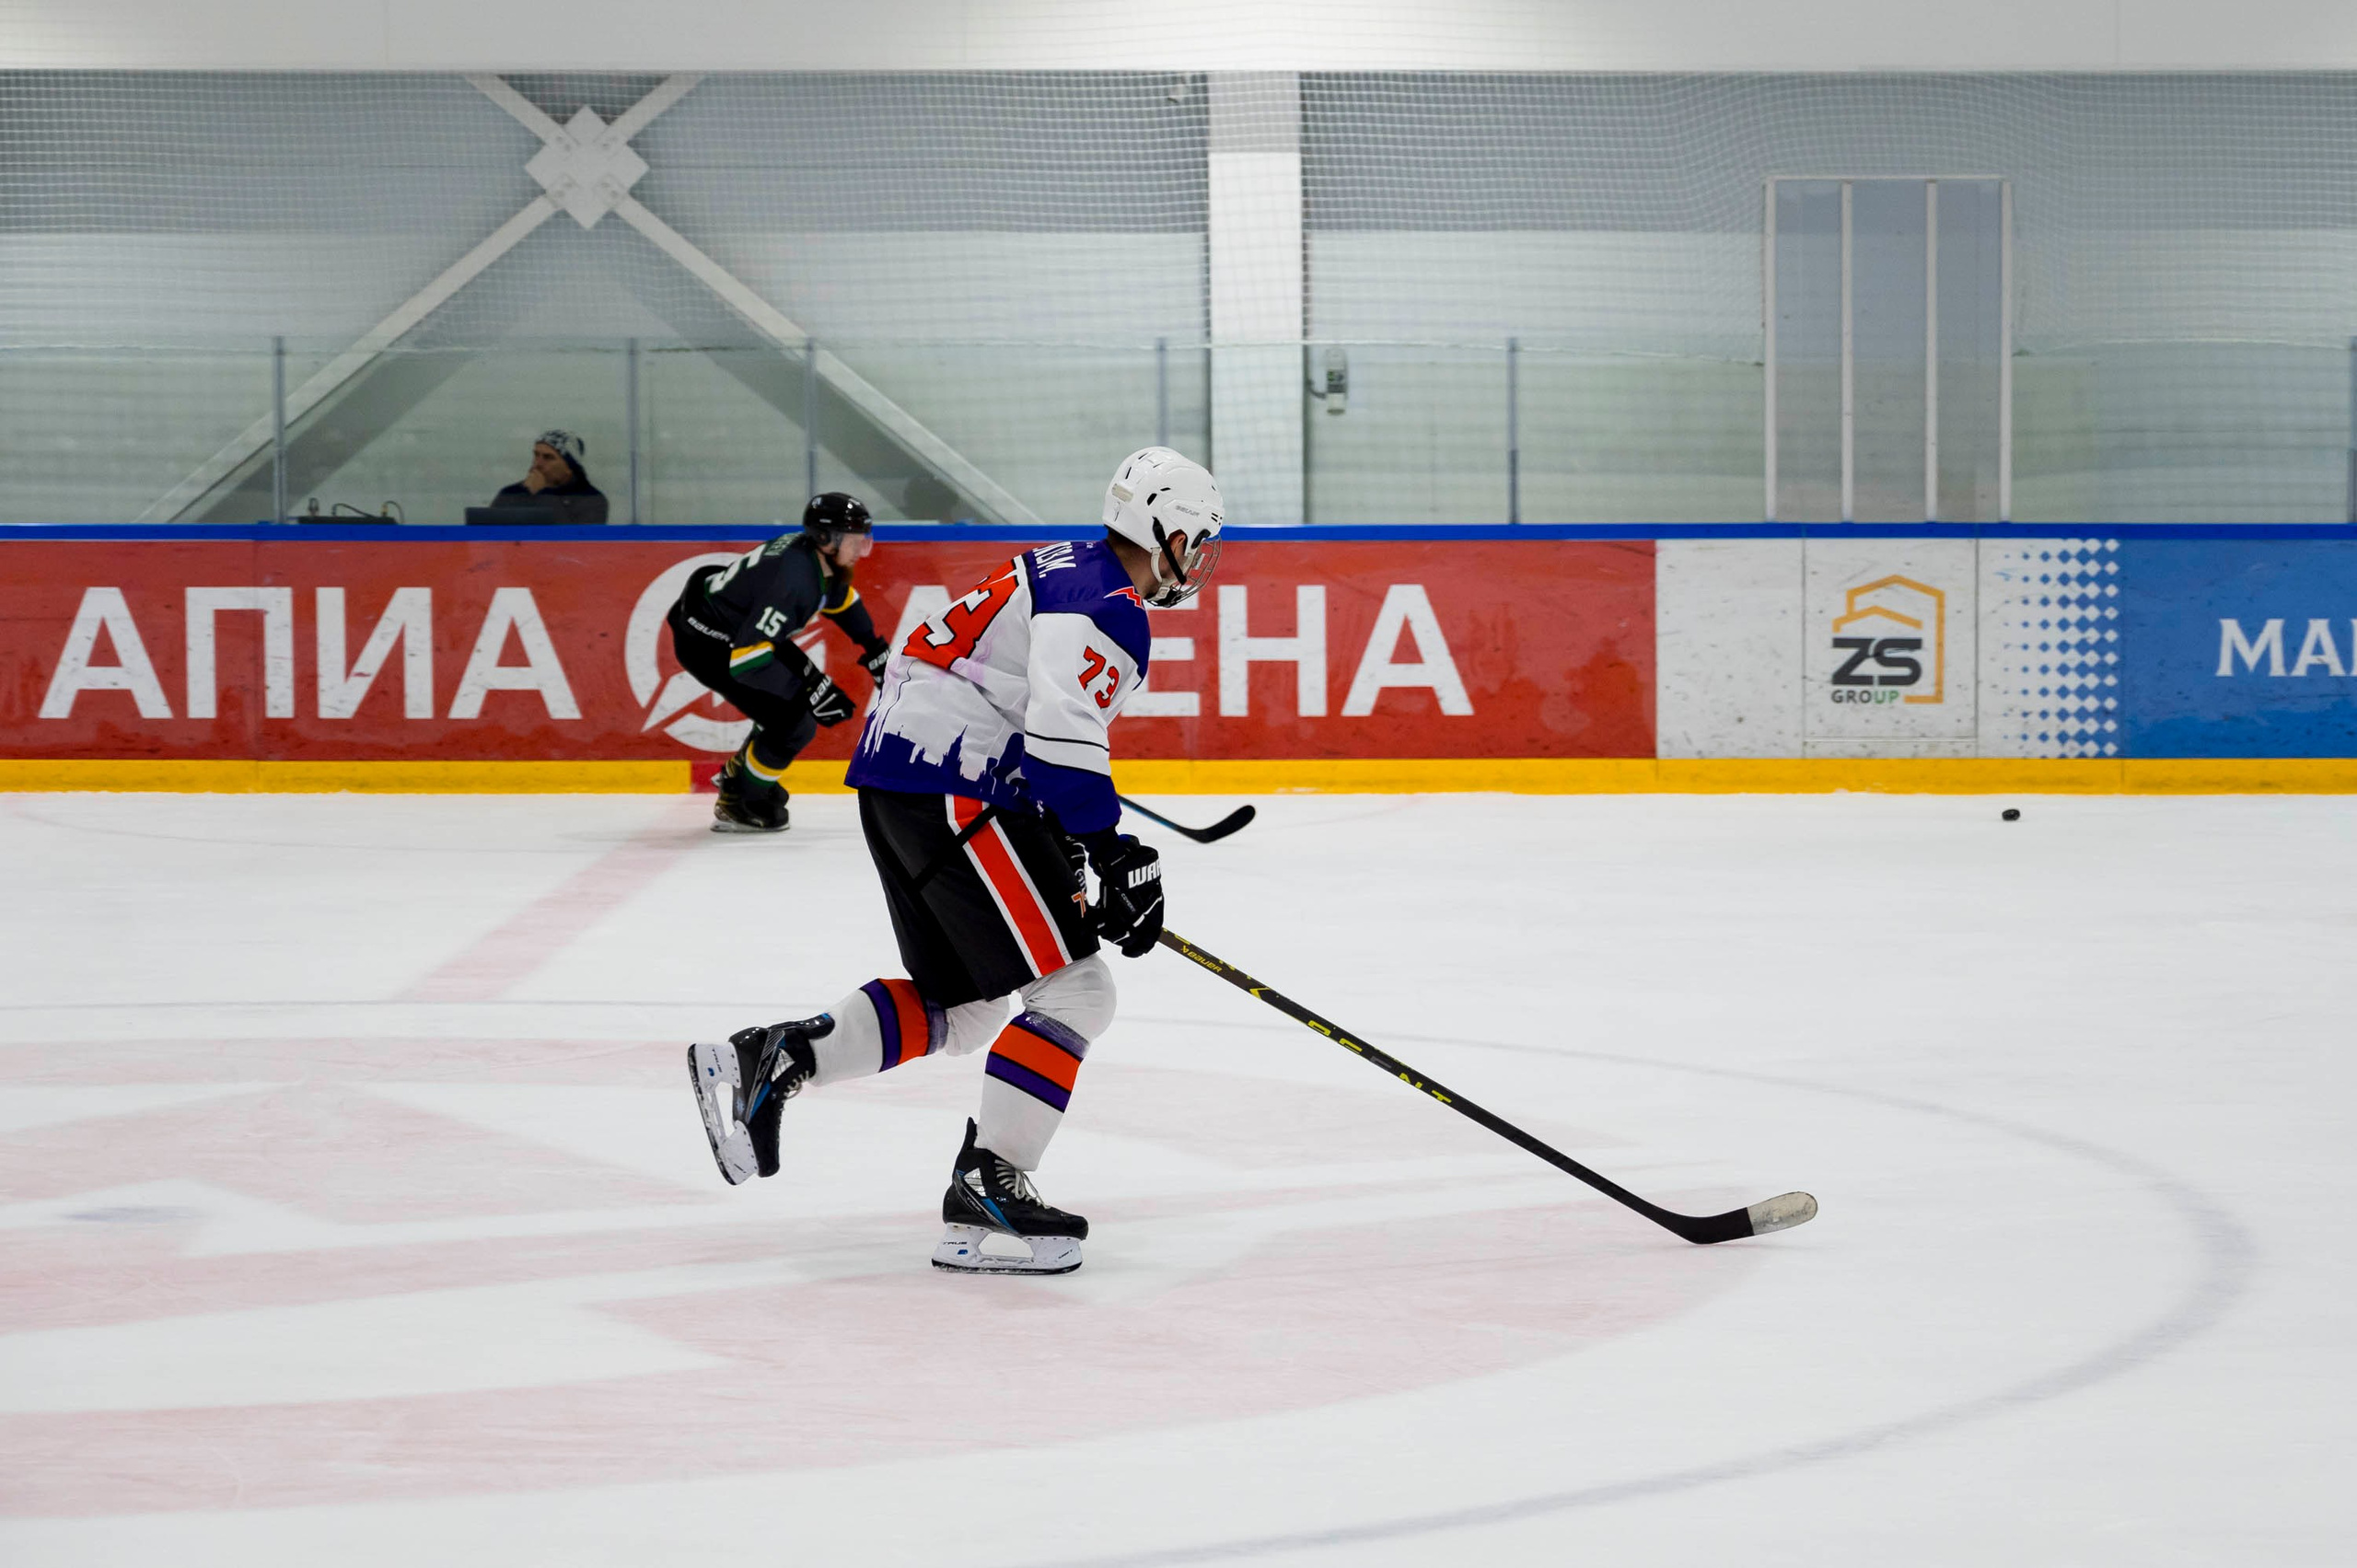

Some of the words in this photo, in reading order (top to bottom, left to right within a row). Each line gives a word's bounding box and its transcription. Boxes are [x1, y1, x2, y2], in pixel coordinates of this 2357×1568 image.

[687, 616, 731, 643] BAUER
[755, 606, 788, 638] 15
[39, 587, 583, 719] АПИА
[1831, 637, 1922, 686] ZS
[2215, 618, 2357, 677] МА
[1077, 645, 1121, 710] 73
[1830, 690, 1900, 704] GROUP
[1127, 859, 1161, 889] WA
[1188, 951, 1223, 972] BAUER
